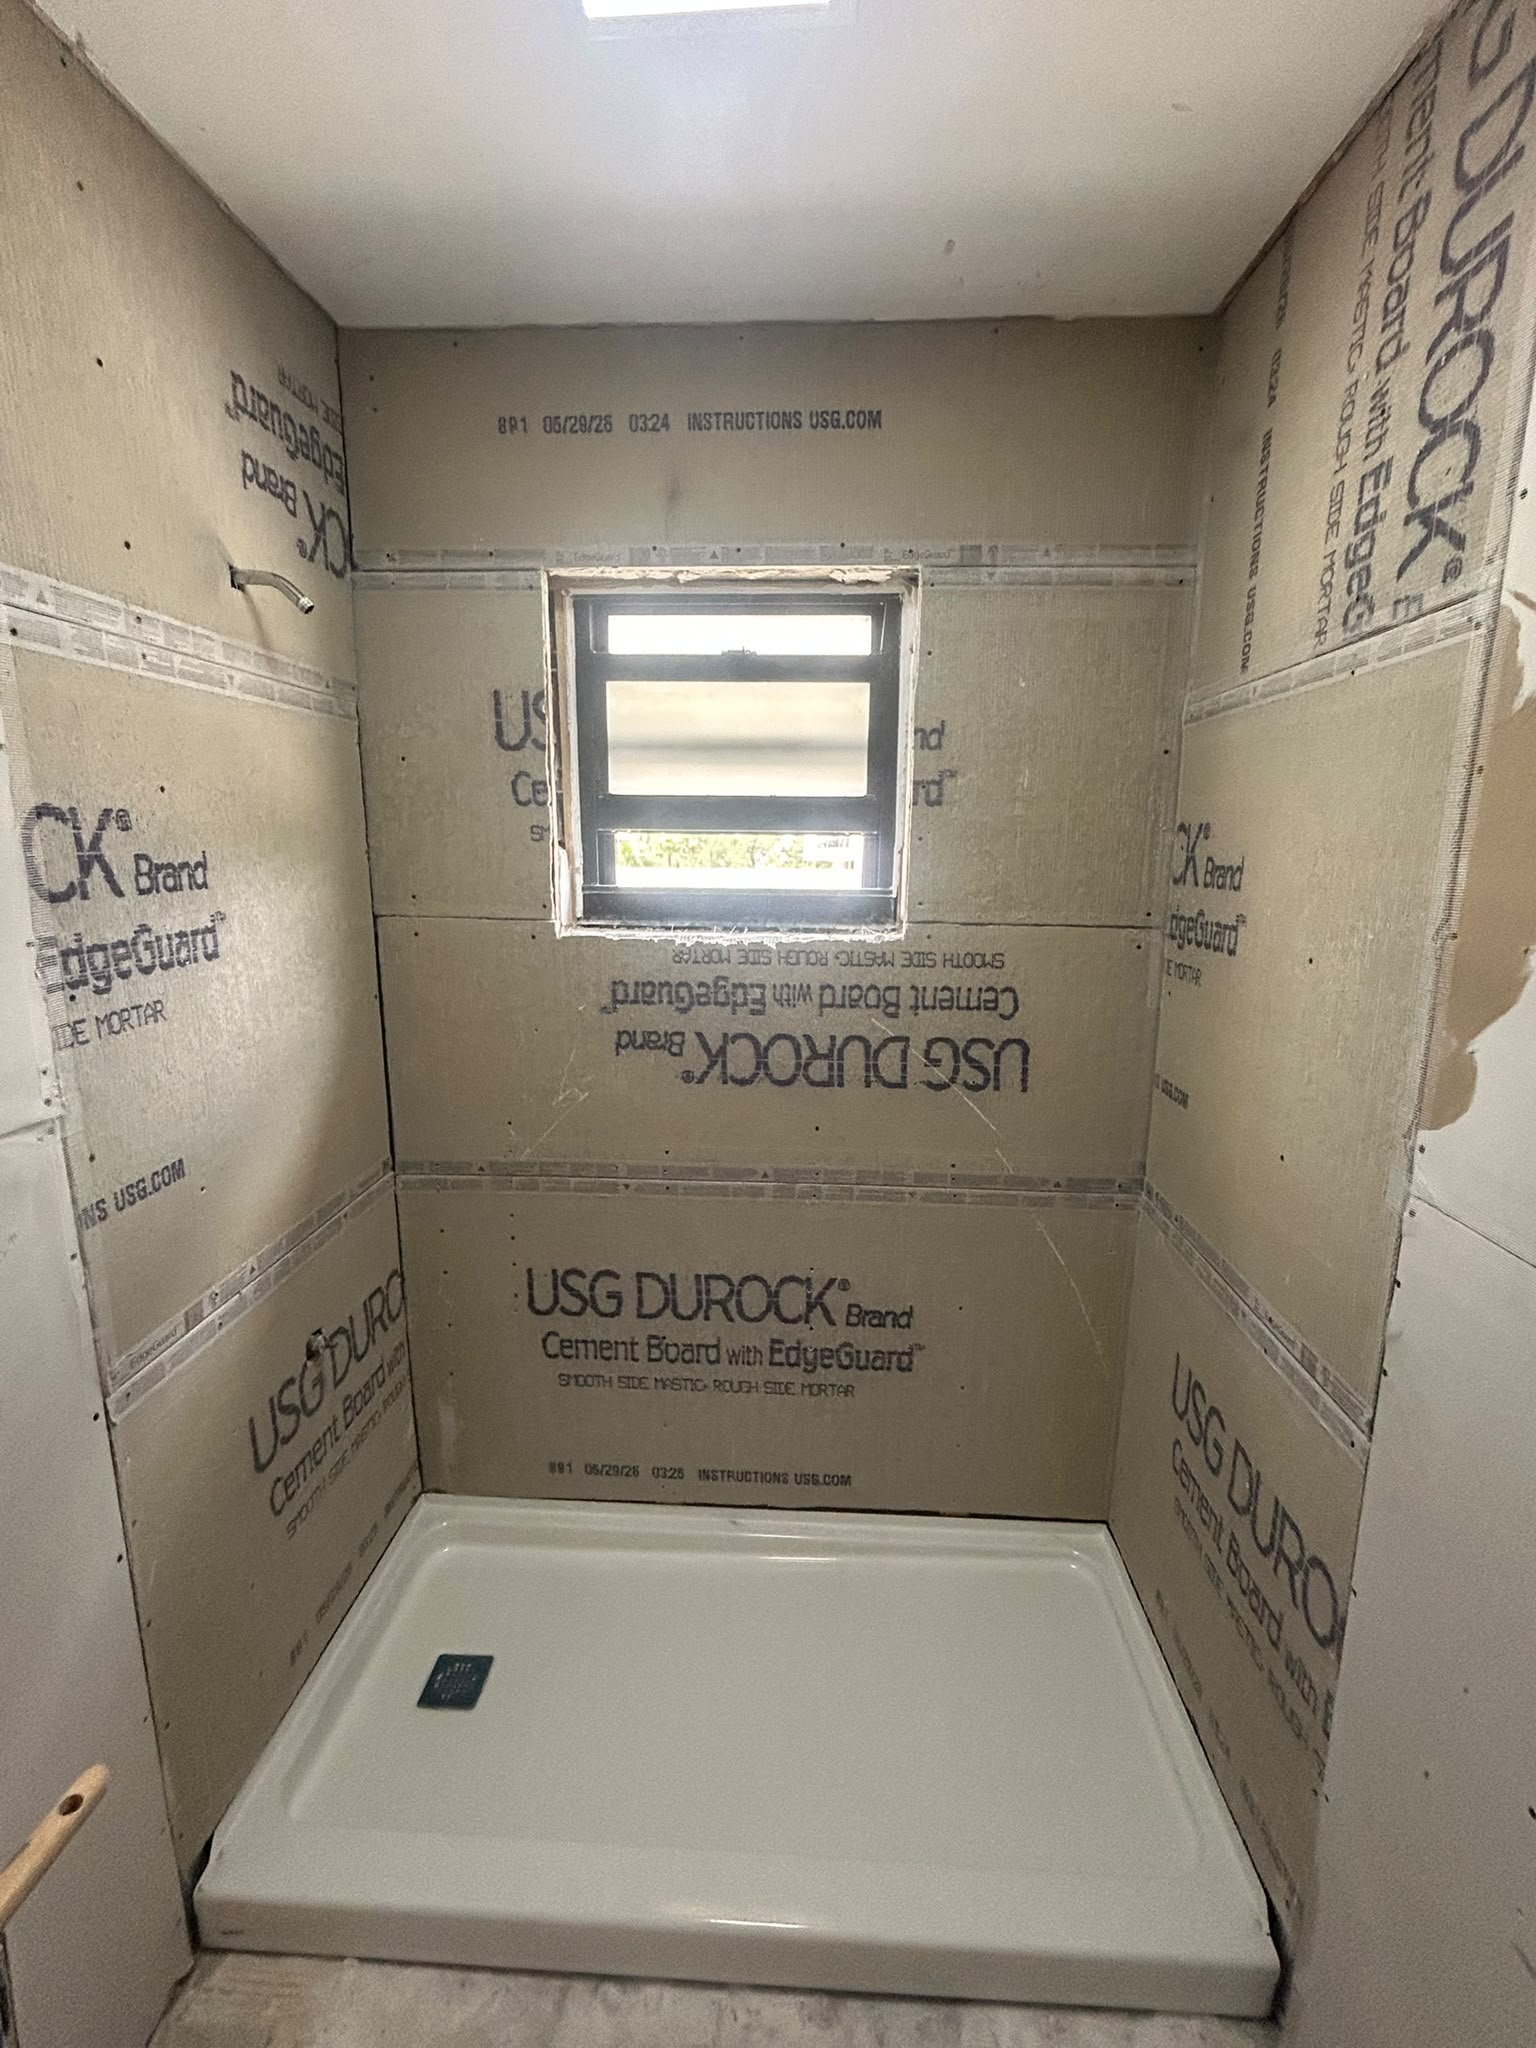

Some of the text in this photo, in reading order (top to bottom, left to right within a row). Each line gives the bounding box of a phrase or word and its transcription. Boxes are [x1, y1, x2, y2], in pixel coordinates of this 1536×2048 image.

[1376, 189, 1432, 375] Board
[687, 411, 802, 431] INSTRUCTIONS
[809, 410, 882, 430] USG.COM
[1363, 376, 1392, 463] with
[241, 449, 298, 518] Brand
[1249, 427, 1273, 580] INSTRUCTIONS
[1325, 478, 1346, 545] SIDE
[1313, 549, 1337, 650] MORTAR
[1241, 583, 1257, 675] USG.COM
[133, 851, 209, 896] Brand
[1203, 855, 1245, 892] Brand
[672, 948, 731, 966] MORTAR
[737, 949, 772, 966] SIDE
[778, 951, 829, 968] ROUGH
[901, 952, 937, 969] SIDE
[942, 952, 1006, 969] SMOOTH
[772, 982, 812, 1009] with
[819, 983, 901, 1018] Board
[910, 983, 1020, 1020] Cement
[95, 999, 168, 1040] MORTAR
[615, 1029, 686, 1057] Brand
[924, 1037, 1031, 1093] USG
[113, 1158, 186, 1213] USG.COM
[527, 1267, 624, 1319] USG
[846, 1303, 914, 1329] Brand
[541, 1331, 640, 1363] Cement
[646, 1335, 721, 1366] Board
[725, 1344, 763, 1367] with
[558, 1373, 613, 1389] SMOOTH
[618, 1375, 650, 1391] SIDE
[713, 1378, 760, 1395] ROUGH
[763, 1380, 796, 1397] SIDE
[801, 1382, 855, 1398] MORTAR
[249, 1357, 325, 1474] USG
[270, 1413, 341, 1517] Cement
[343, 1353, 386, 1431] Board
[1172, 1352, 1226, 1477] USG
[698, 1468, 789, 1485] INSTRUCTIONS
[794, 1471, 852, 1487] USG.COM
[1172, 1437, 1223, 1555] Cement
[1226, 1529, 1283, 1651] Board
[1285, 1643, 1319, 1717] with
